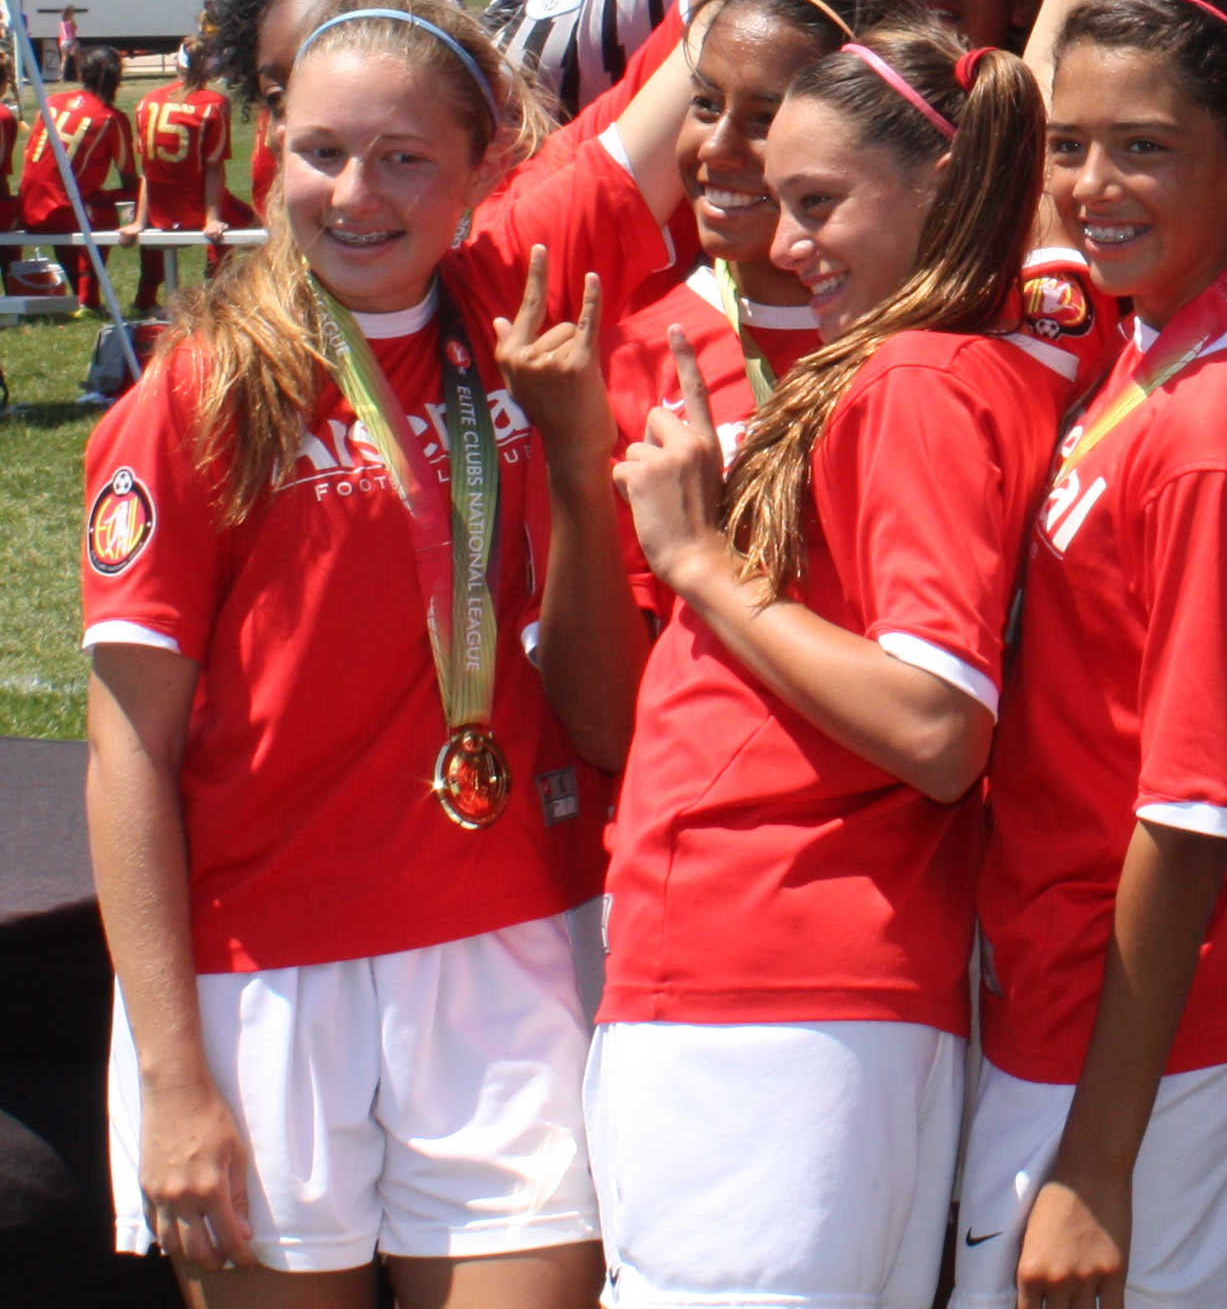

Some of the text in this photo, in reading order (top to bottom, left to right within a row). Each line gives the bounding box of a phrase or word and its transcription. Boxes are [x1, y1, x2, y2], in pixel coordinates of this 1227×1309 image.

[147, 101, 196, 163] 15
[457, 385, 486, 671] ELITE CLUBS NATIONAL LEAGUE
